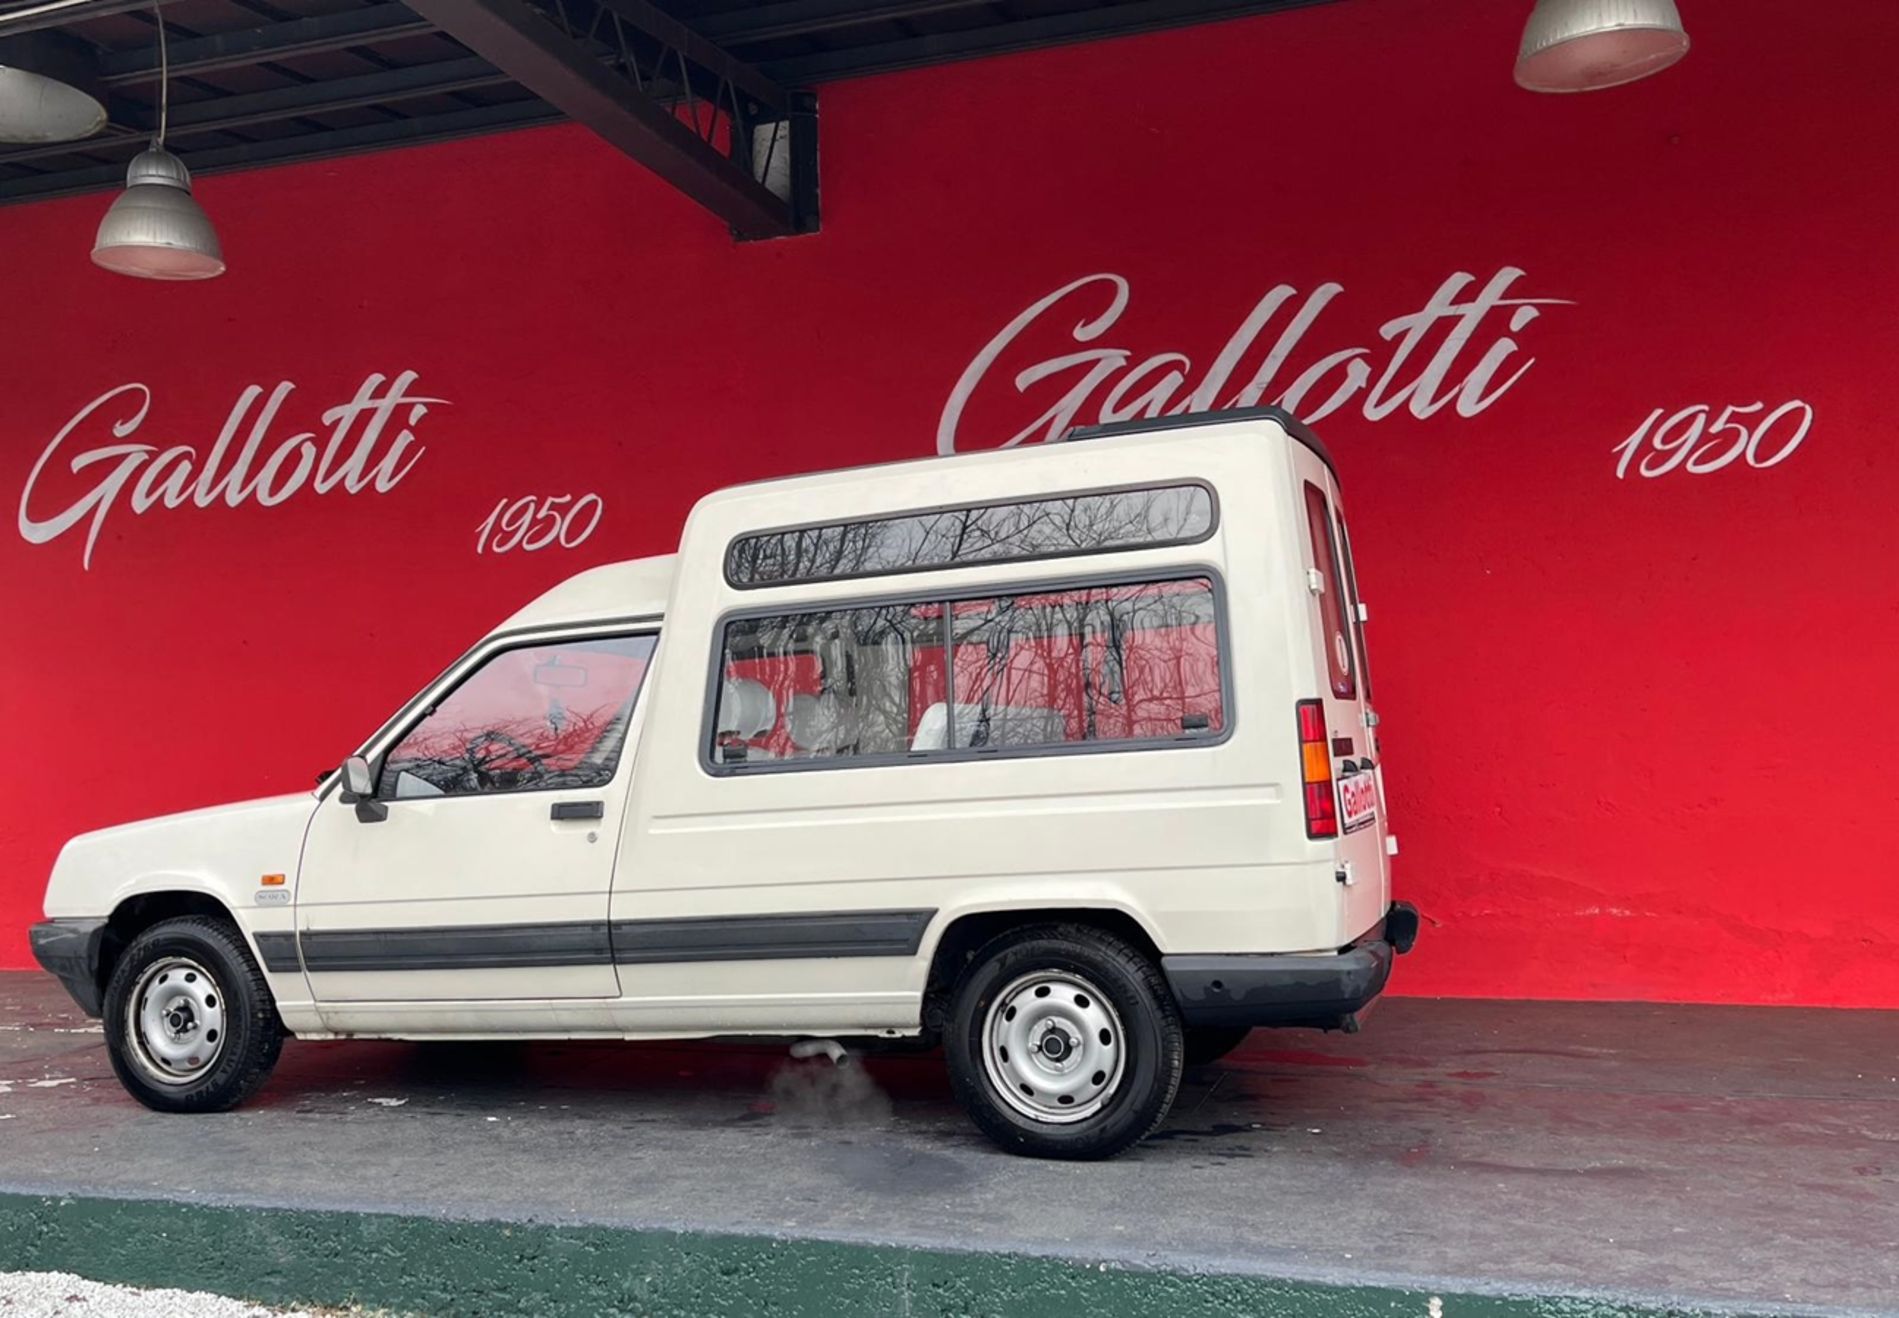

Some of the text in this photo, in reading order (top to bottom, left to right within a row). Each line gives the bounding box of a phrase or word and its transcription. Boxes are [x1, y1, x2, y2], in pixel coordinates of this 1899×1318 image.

[936, 265, 1579, 456] Gallotti
[18, 369, 453, 571] Gallotti
[1611, 399, 1814, 480] 1950
[474, 493, 604, 555] 1950
